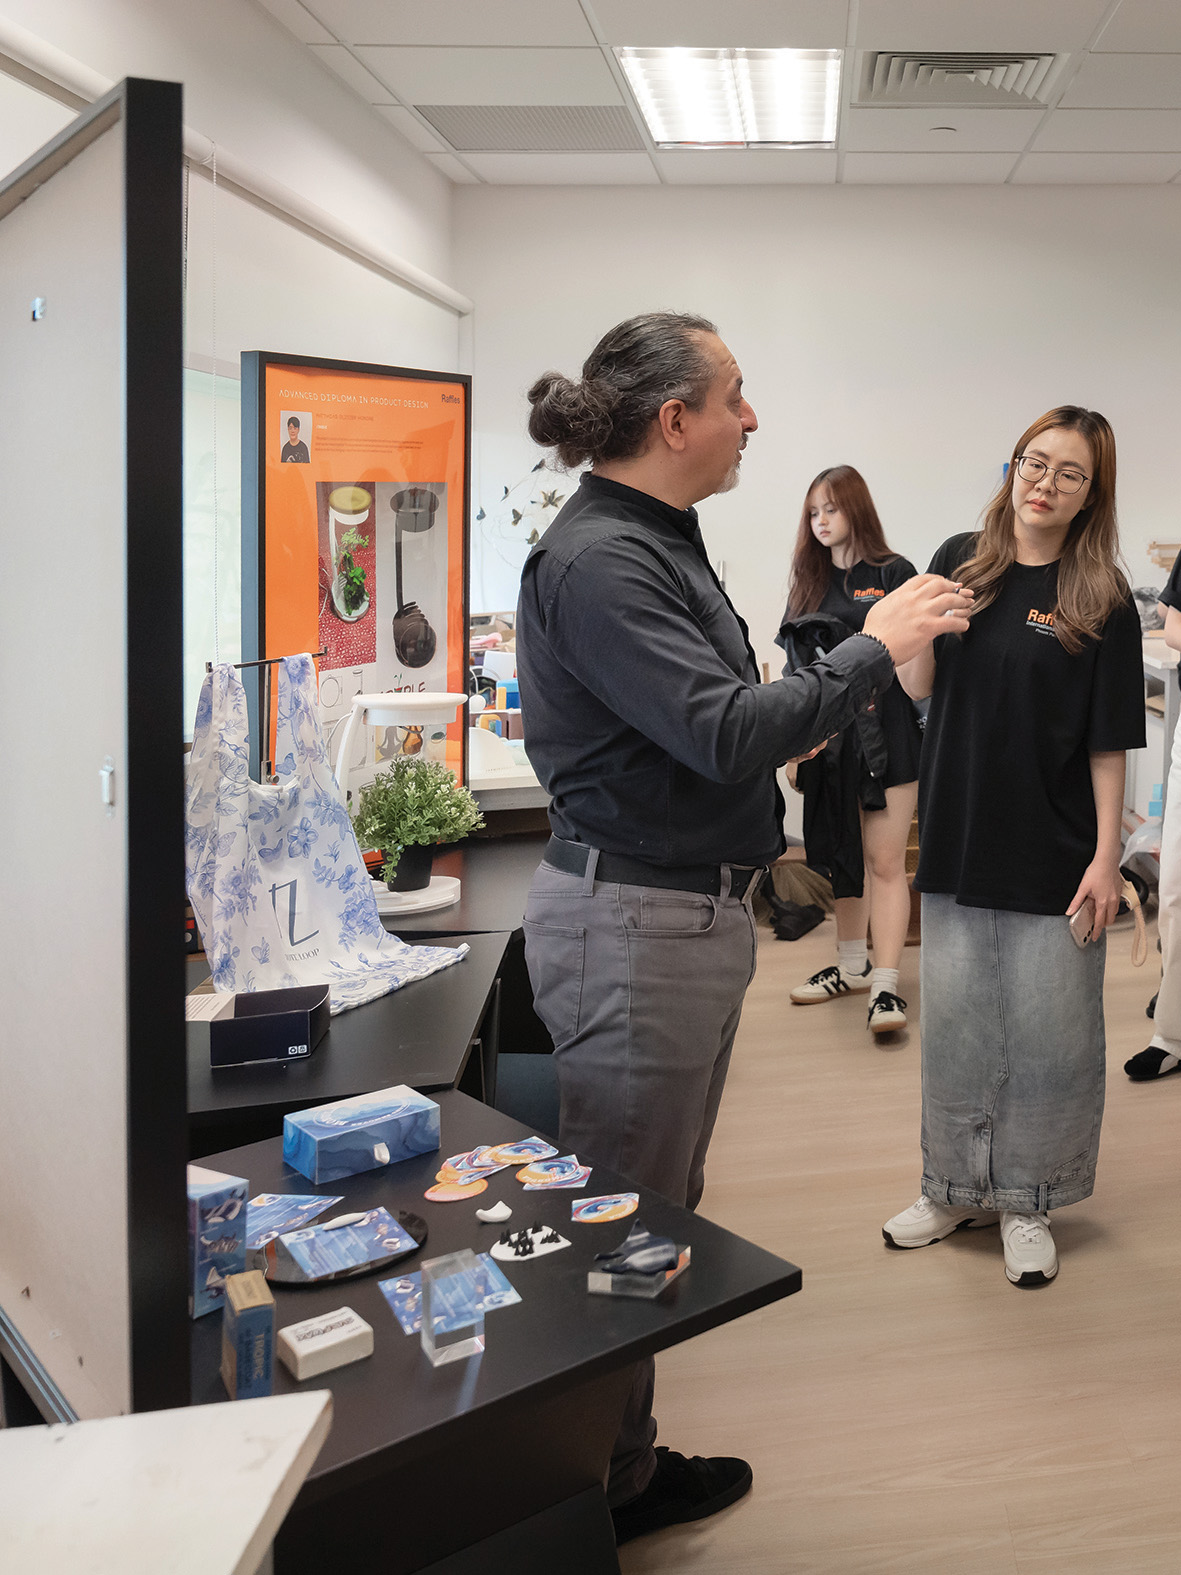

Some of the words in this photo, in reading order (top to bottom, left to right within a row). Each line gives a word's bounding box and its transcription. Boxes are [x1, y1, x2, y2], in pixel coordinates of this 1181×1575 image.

[279, 389, 319, 401] ADVANCED
[320, 393, 357, 403] DIPLOMA
[359, 395, 368, 404] IN
[370, 396, 401, 407] PRODUCT
[403, 399, 429, 409] DESIGN
[441, 394, 461, 404] Raffles
[253, 1334, 265, 1379] TROPIC
